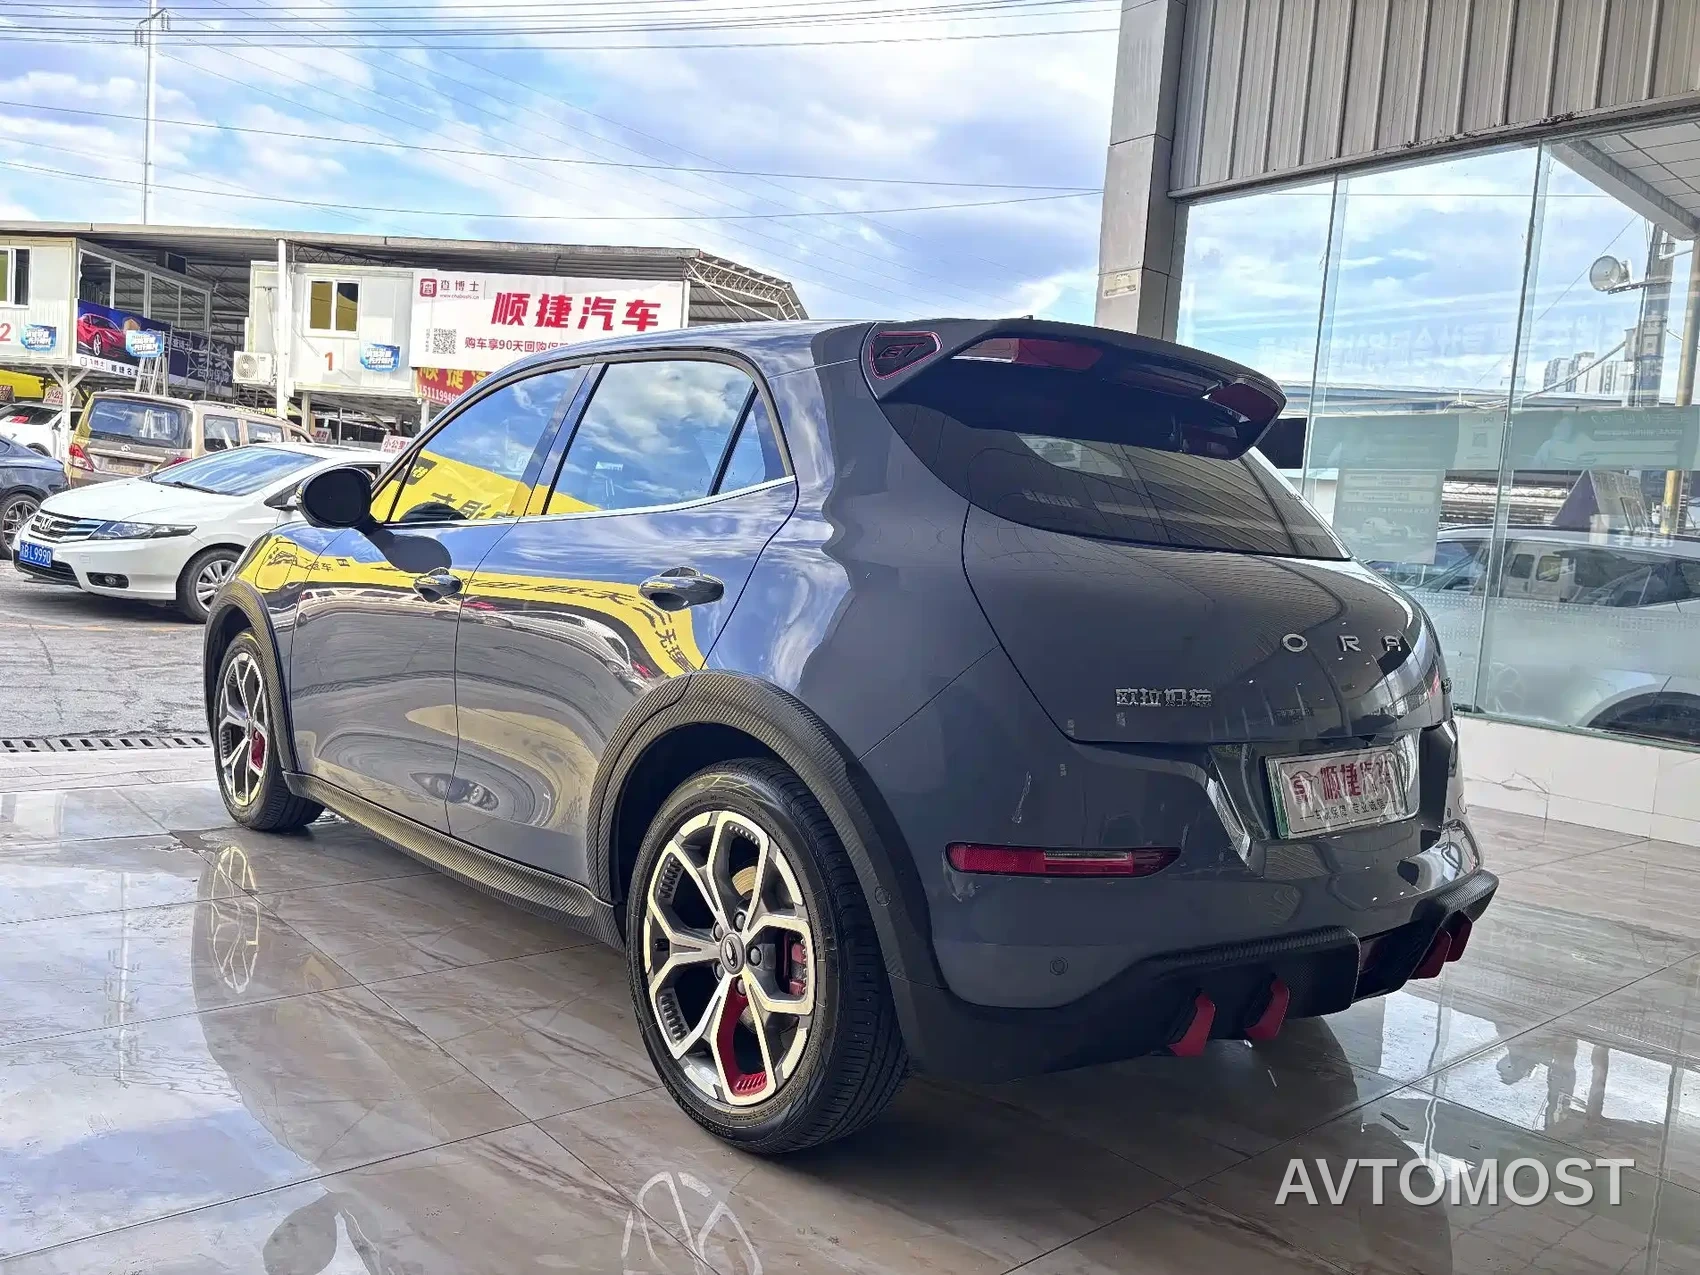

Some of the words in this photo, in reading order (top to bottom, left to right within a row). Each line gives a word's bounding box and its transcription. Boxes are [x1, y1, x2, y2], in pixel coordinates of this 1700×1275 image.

[490, 292, 662, 332] 顺捷汽车
[0, 323, 12, 341] 2
[464, 337, 569, 353] 购车享90天回购保
[325, 352, 334, 371] 1
[384, 439, 410, 450] 小公里
[1281, 633, 1404, 653] ORA
